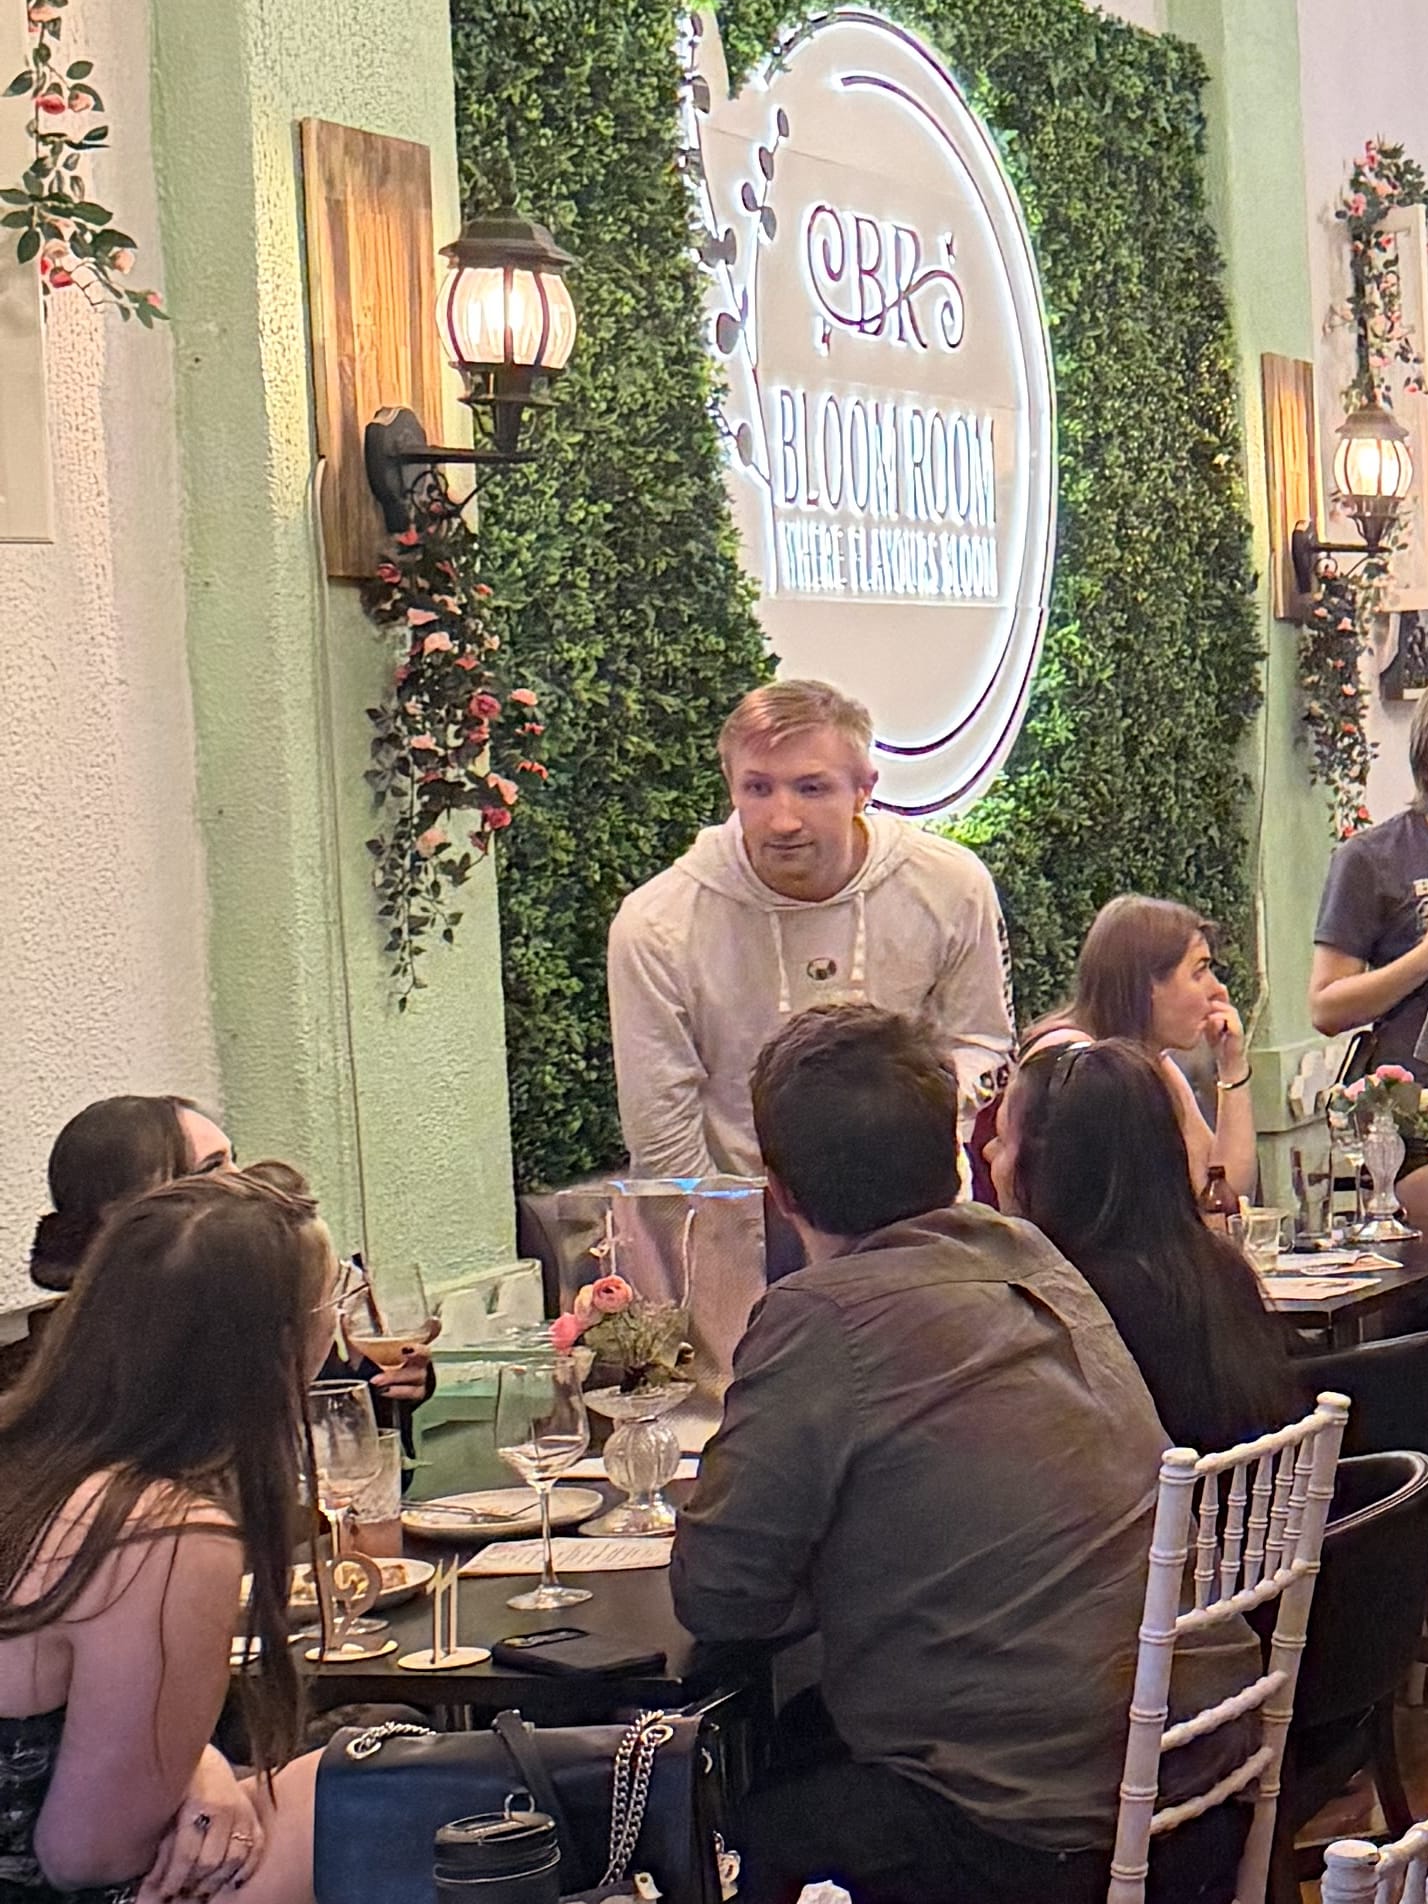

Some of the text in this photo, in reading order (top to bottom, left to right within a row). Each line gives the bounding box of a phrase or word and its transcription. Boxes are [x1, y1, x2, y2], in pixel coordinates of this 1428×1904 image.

[774, 386, 997, 528] BLOOM ROOM
[425, 1553, 460, 1664] 11
